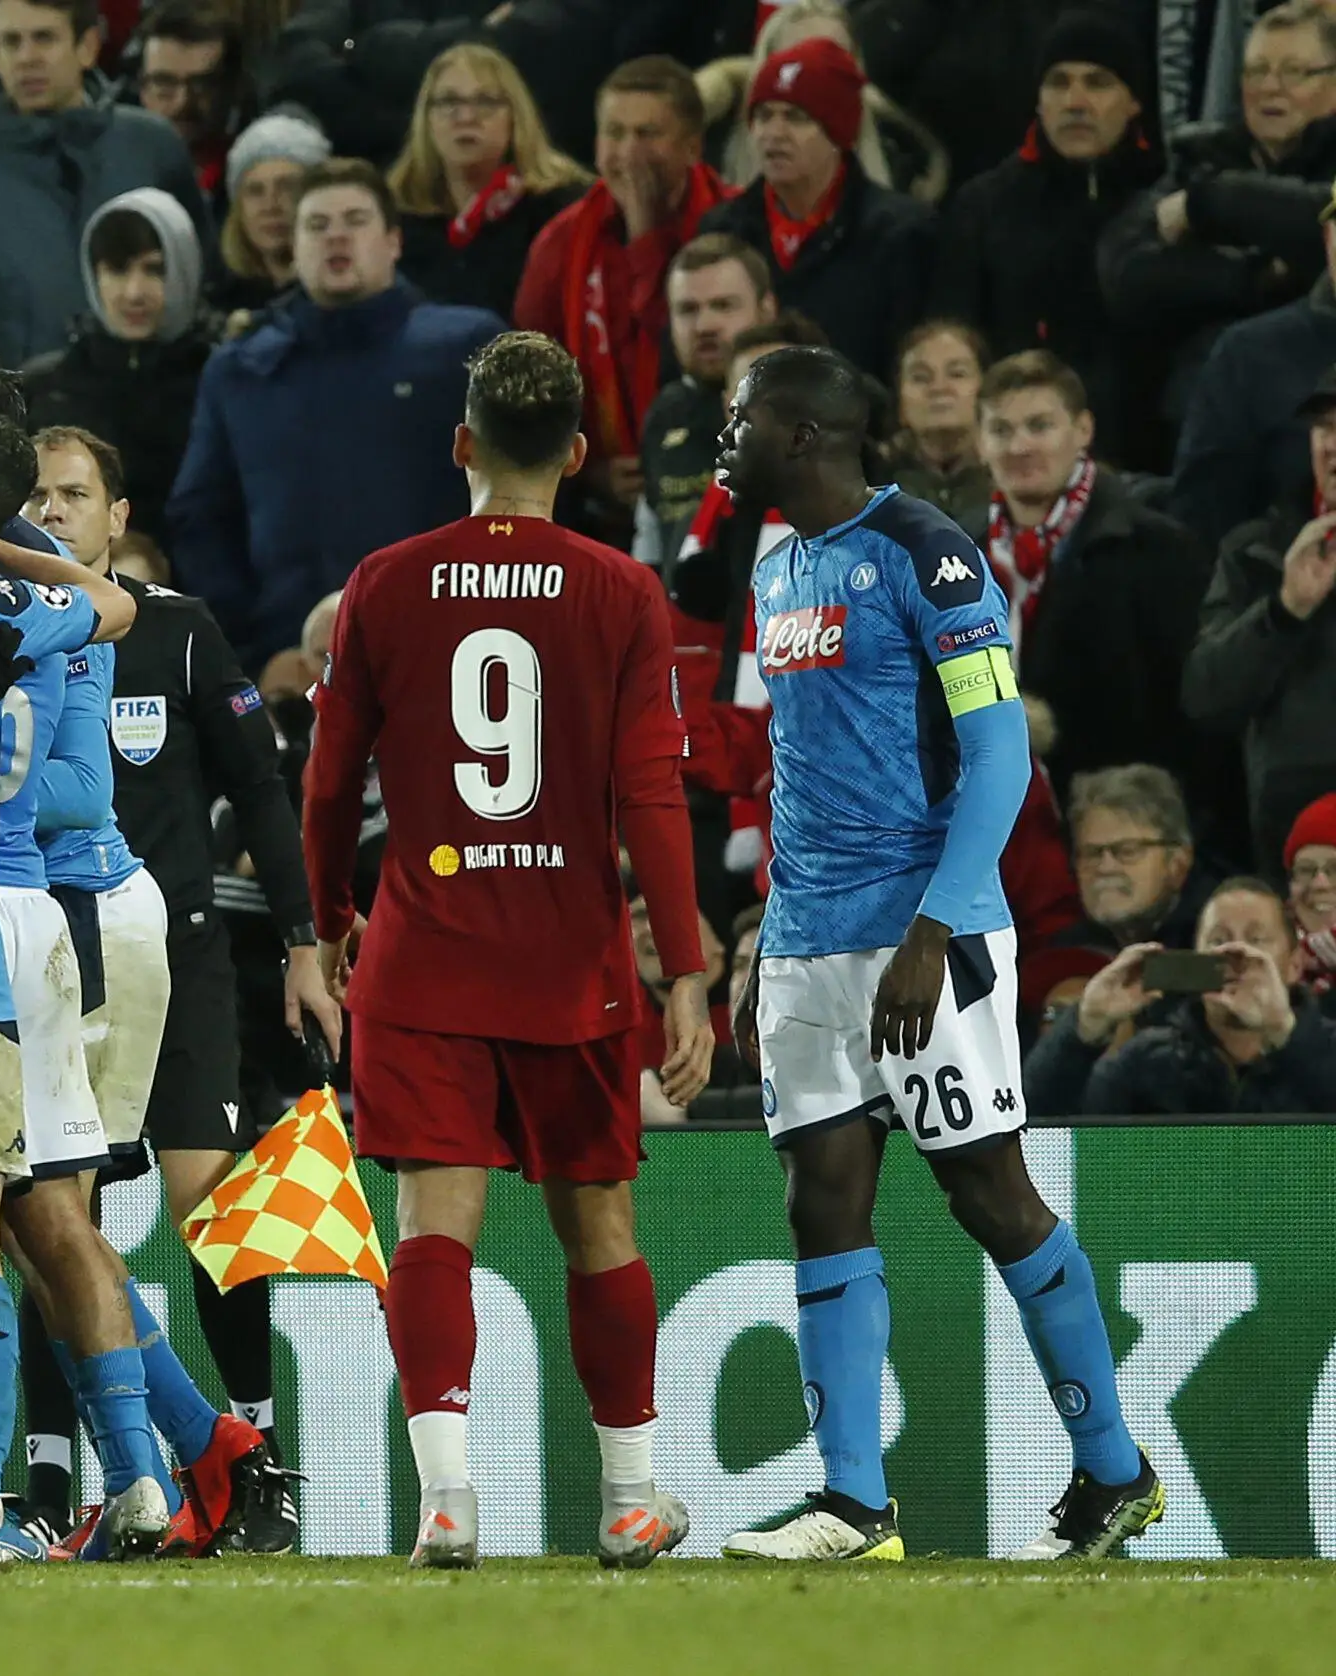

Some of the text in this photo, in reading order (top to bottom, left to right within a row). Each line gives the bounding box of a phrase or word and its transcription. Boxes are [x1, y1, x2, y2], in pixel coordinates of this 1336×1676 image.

[431, 562, 564, 599] FIRMINO
[763, 615, 843, 668] Lete
[954, 623, 996, 645] RESPECT
[116, 701, 161, 718] FIFA
[451, 628, 542, 821] 9
[129, 750, 151, 758] 2019
[464, 844, 507, 870] RIGHT
[510, 844, 533, 868] TO
[903, 1064, 974, 1141] 26
